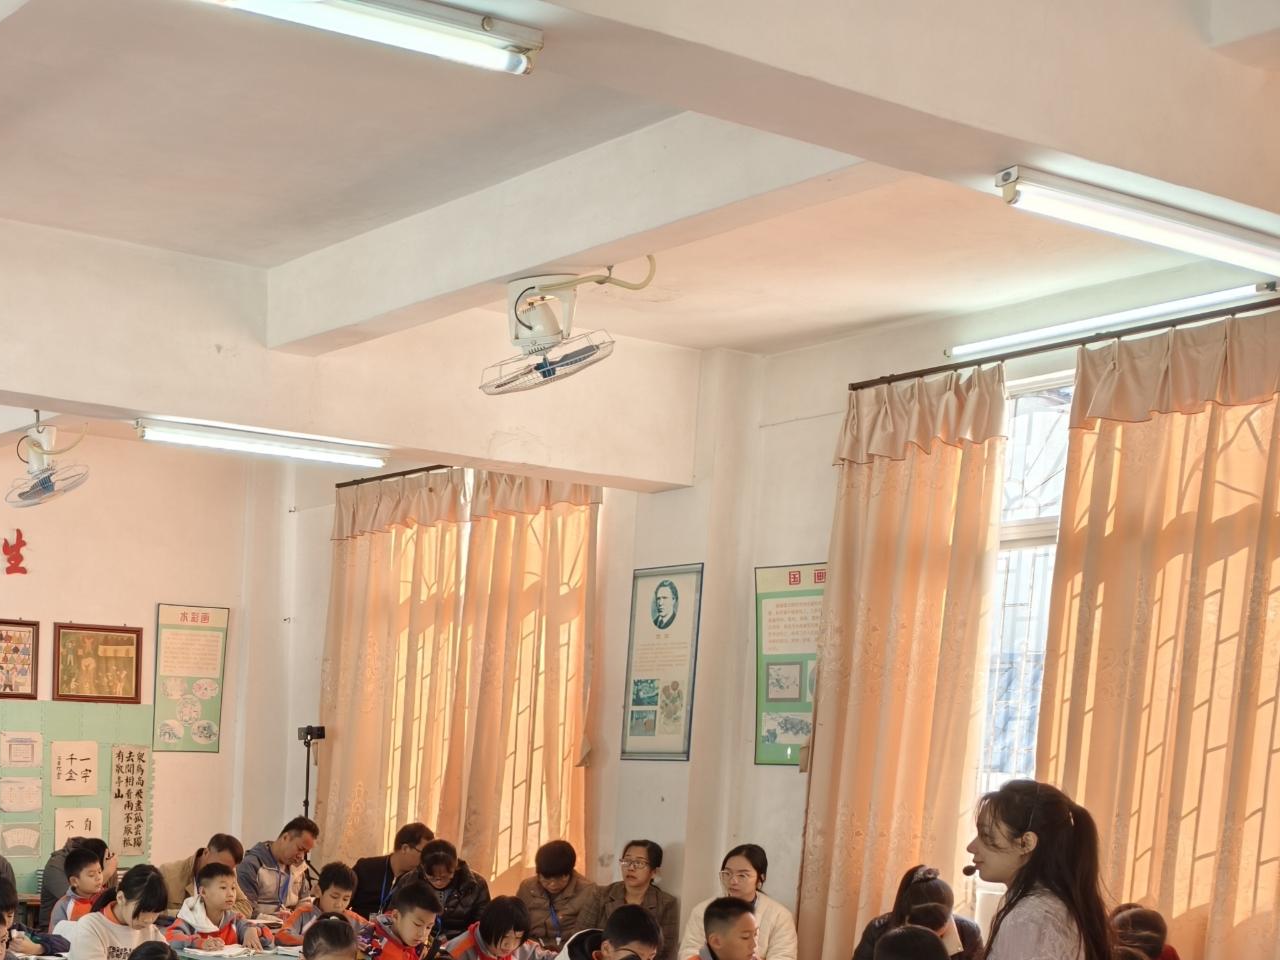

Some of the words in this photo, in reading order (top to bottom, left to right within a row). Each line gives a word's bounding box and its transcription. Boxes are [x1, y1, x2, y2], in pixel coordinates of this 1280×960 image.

[789, 569, 826, 585] 国画
[180, 611, 209, 623] 水彩画
[79, 757, 92, 783] 一字
[64, 820, 75, 831] 不
